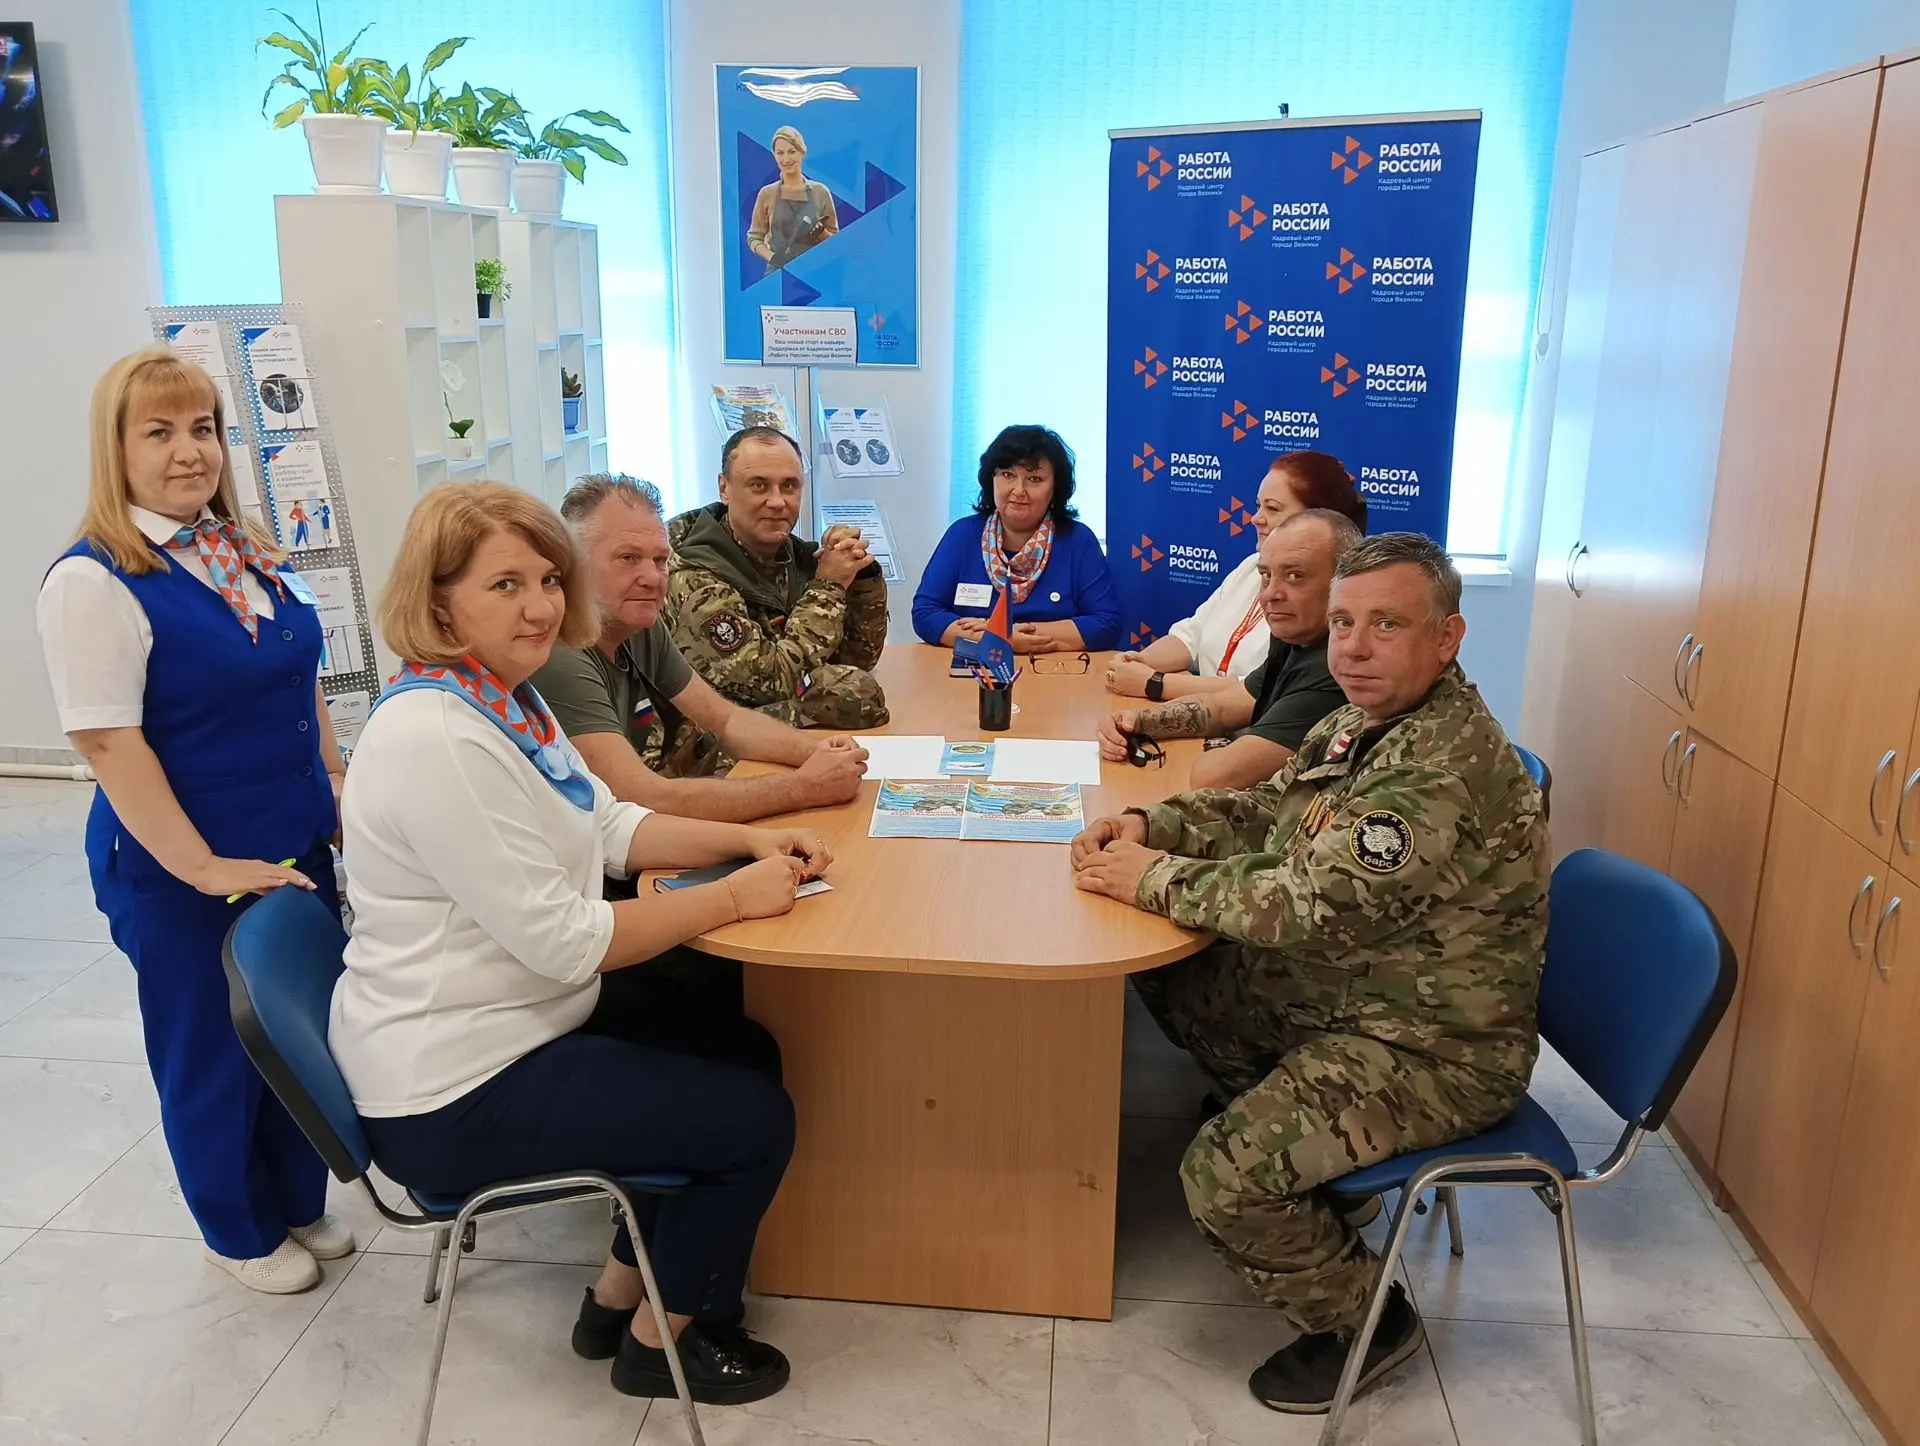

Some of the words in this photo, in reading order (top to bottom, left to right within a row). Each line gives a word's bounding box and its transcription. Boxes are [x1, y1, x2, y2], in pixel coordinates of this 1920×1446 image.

[1379, 142, 1441, 157] РАБОТА
[1178, 151, 1231, 166] РАБОТА
[1378, 158, 1442, 173] РОССИИ
[1178, 166, 1232, 180] РОССИИ
[1273, 202, 1329, 216] РАБОТА
[1272, 217, 1330, 231] РОССИИ
[1175, 257, 1227, 270] РАБОТА
[1373, 257, 1433, 270] РАБОТА
[1175, 271, 1229, 284] РОССИИ
[1371, 272, 1434, 286] РОССИИ
[1268, 309, 1324, 323] РАБОТА
[773, 327, 827, 336] Участникам
[828, 328, 847, 336] СВО
[1268, 324, 1325, 338] РОССИИ
[1172, 356, 1224, 370] РАБОТА
[1172, 370, 1225, 383] РОССИИ
[1366, 363, 1426, 378] РАБОТА
[1365, 378, 1427, 393] РОССИИ
[1264, 409, 1319, 425] РАБОТА
[1263, 424, 1320, 439] РОССИИ
[1170, 452, 1221, 467] РАБОТА
[1170, 466, 1222, 481] РОССИИ
[1361, 466, 1419, 482] РАБОТА
[1360, 480, 1420, 497] РОССИИ
[1169, 544, 1218, 560] РАБОТА
[1169, 557, 1219, 573] РОССИИ
[1364, 855, 1393, 868] барс
